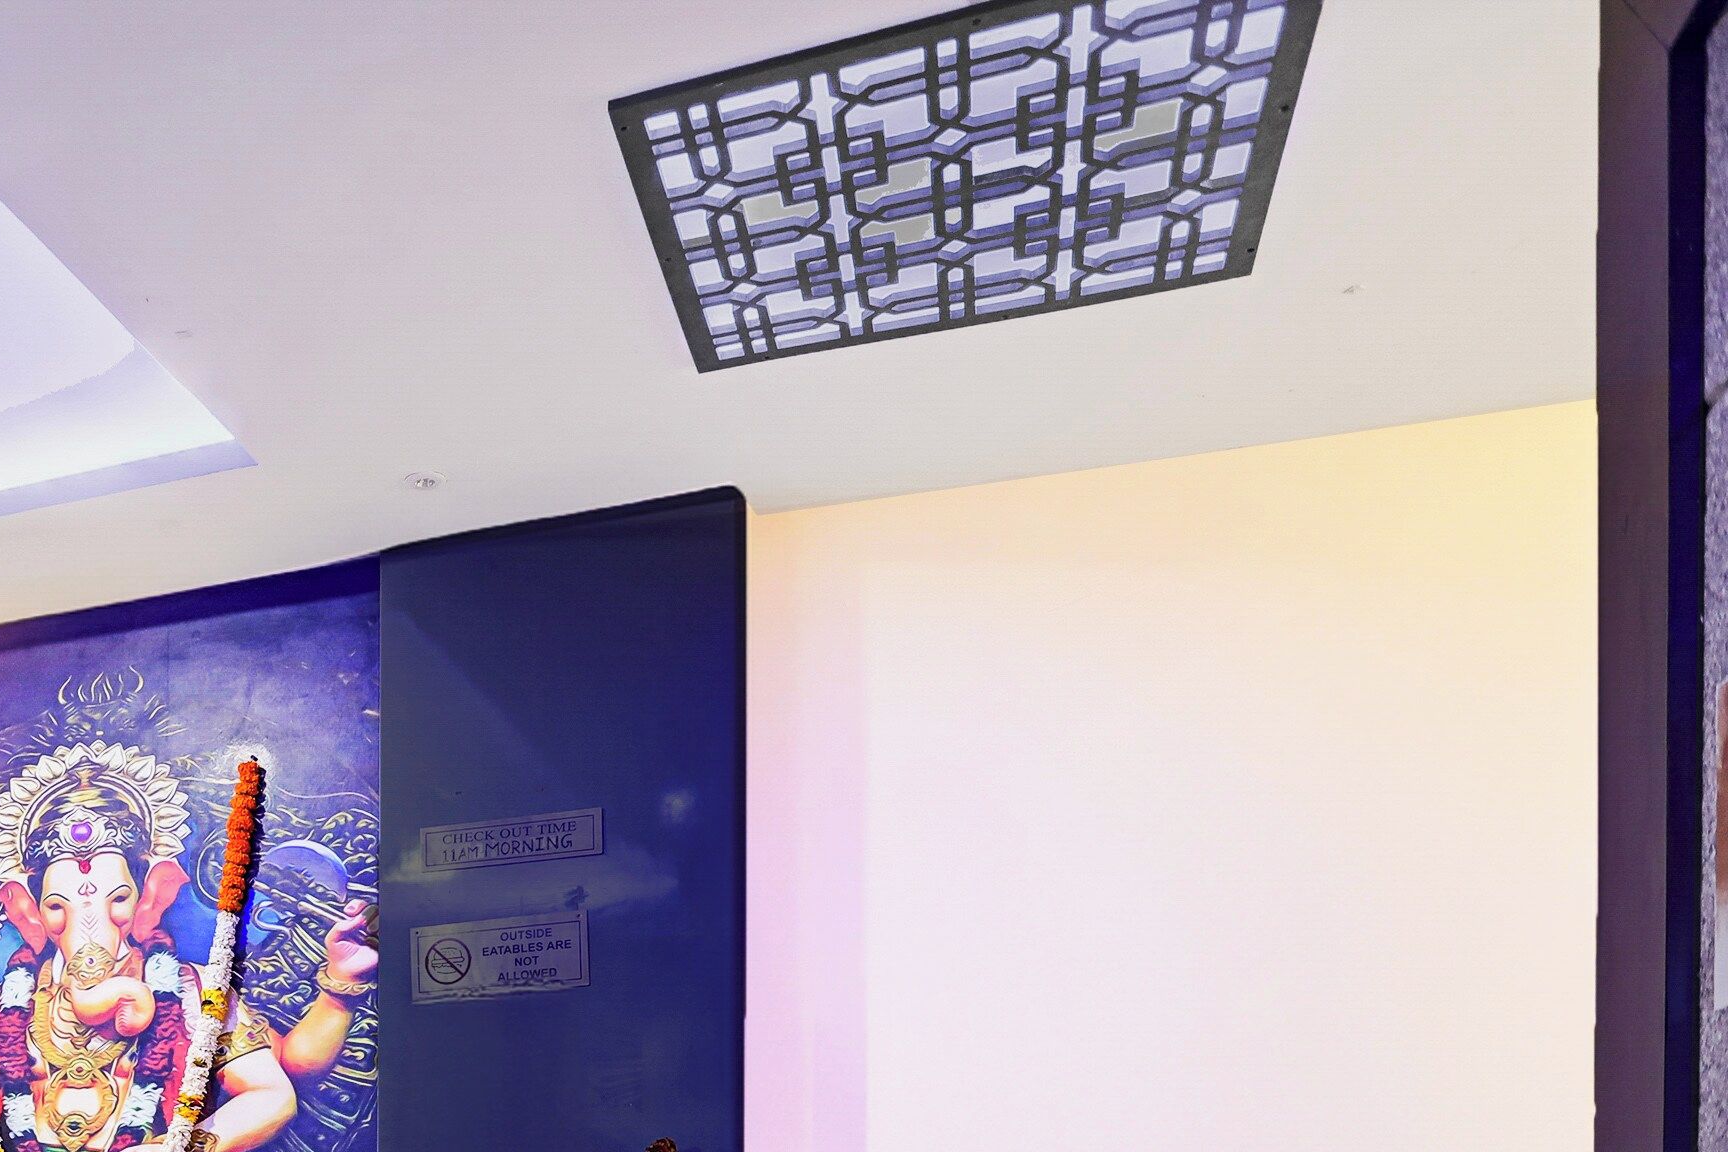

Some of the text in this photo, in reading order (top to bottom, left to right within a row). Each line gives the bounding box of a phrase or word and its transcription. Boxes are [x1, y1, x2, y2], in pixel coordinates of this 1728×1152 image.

[442, 820, 577, 845] CHECK OUT TIME
[442, 833, 573, 862] 11AM MORNING
[500, 927, 553, 942] OUTSIDE
[482, 939, 572, 957] EATABLES ARE
[514, 955, 540, 967] NOT
[497, 967, 558, 982] ALLOWED
